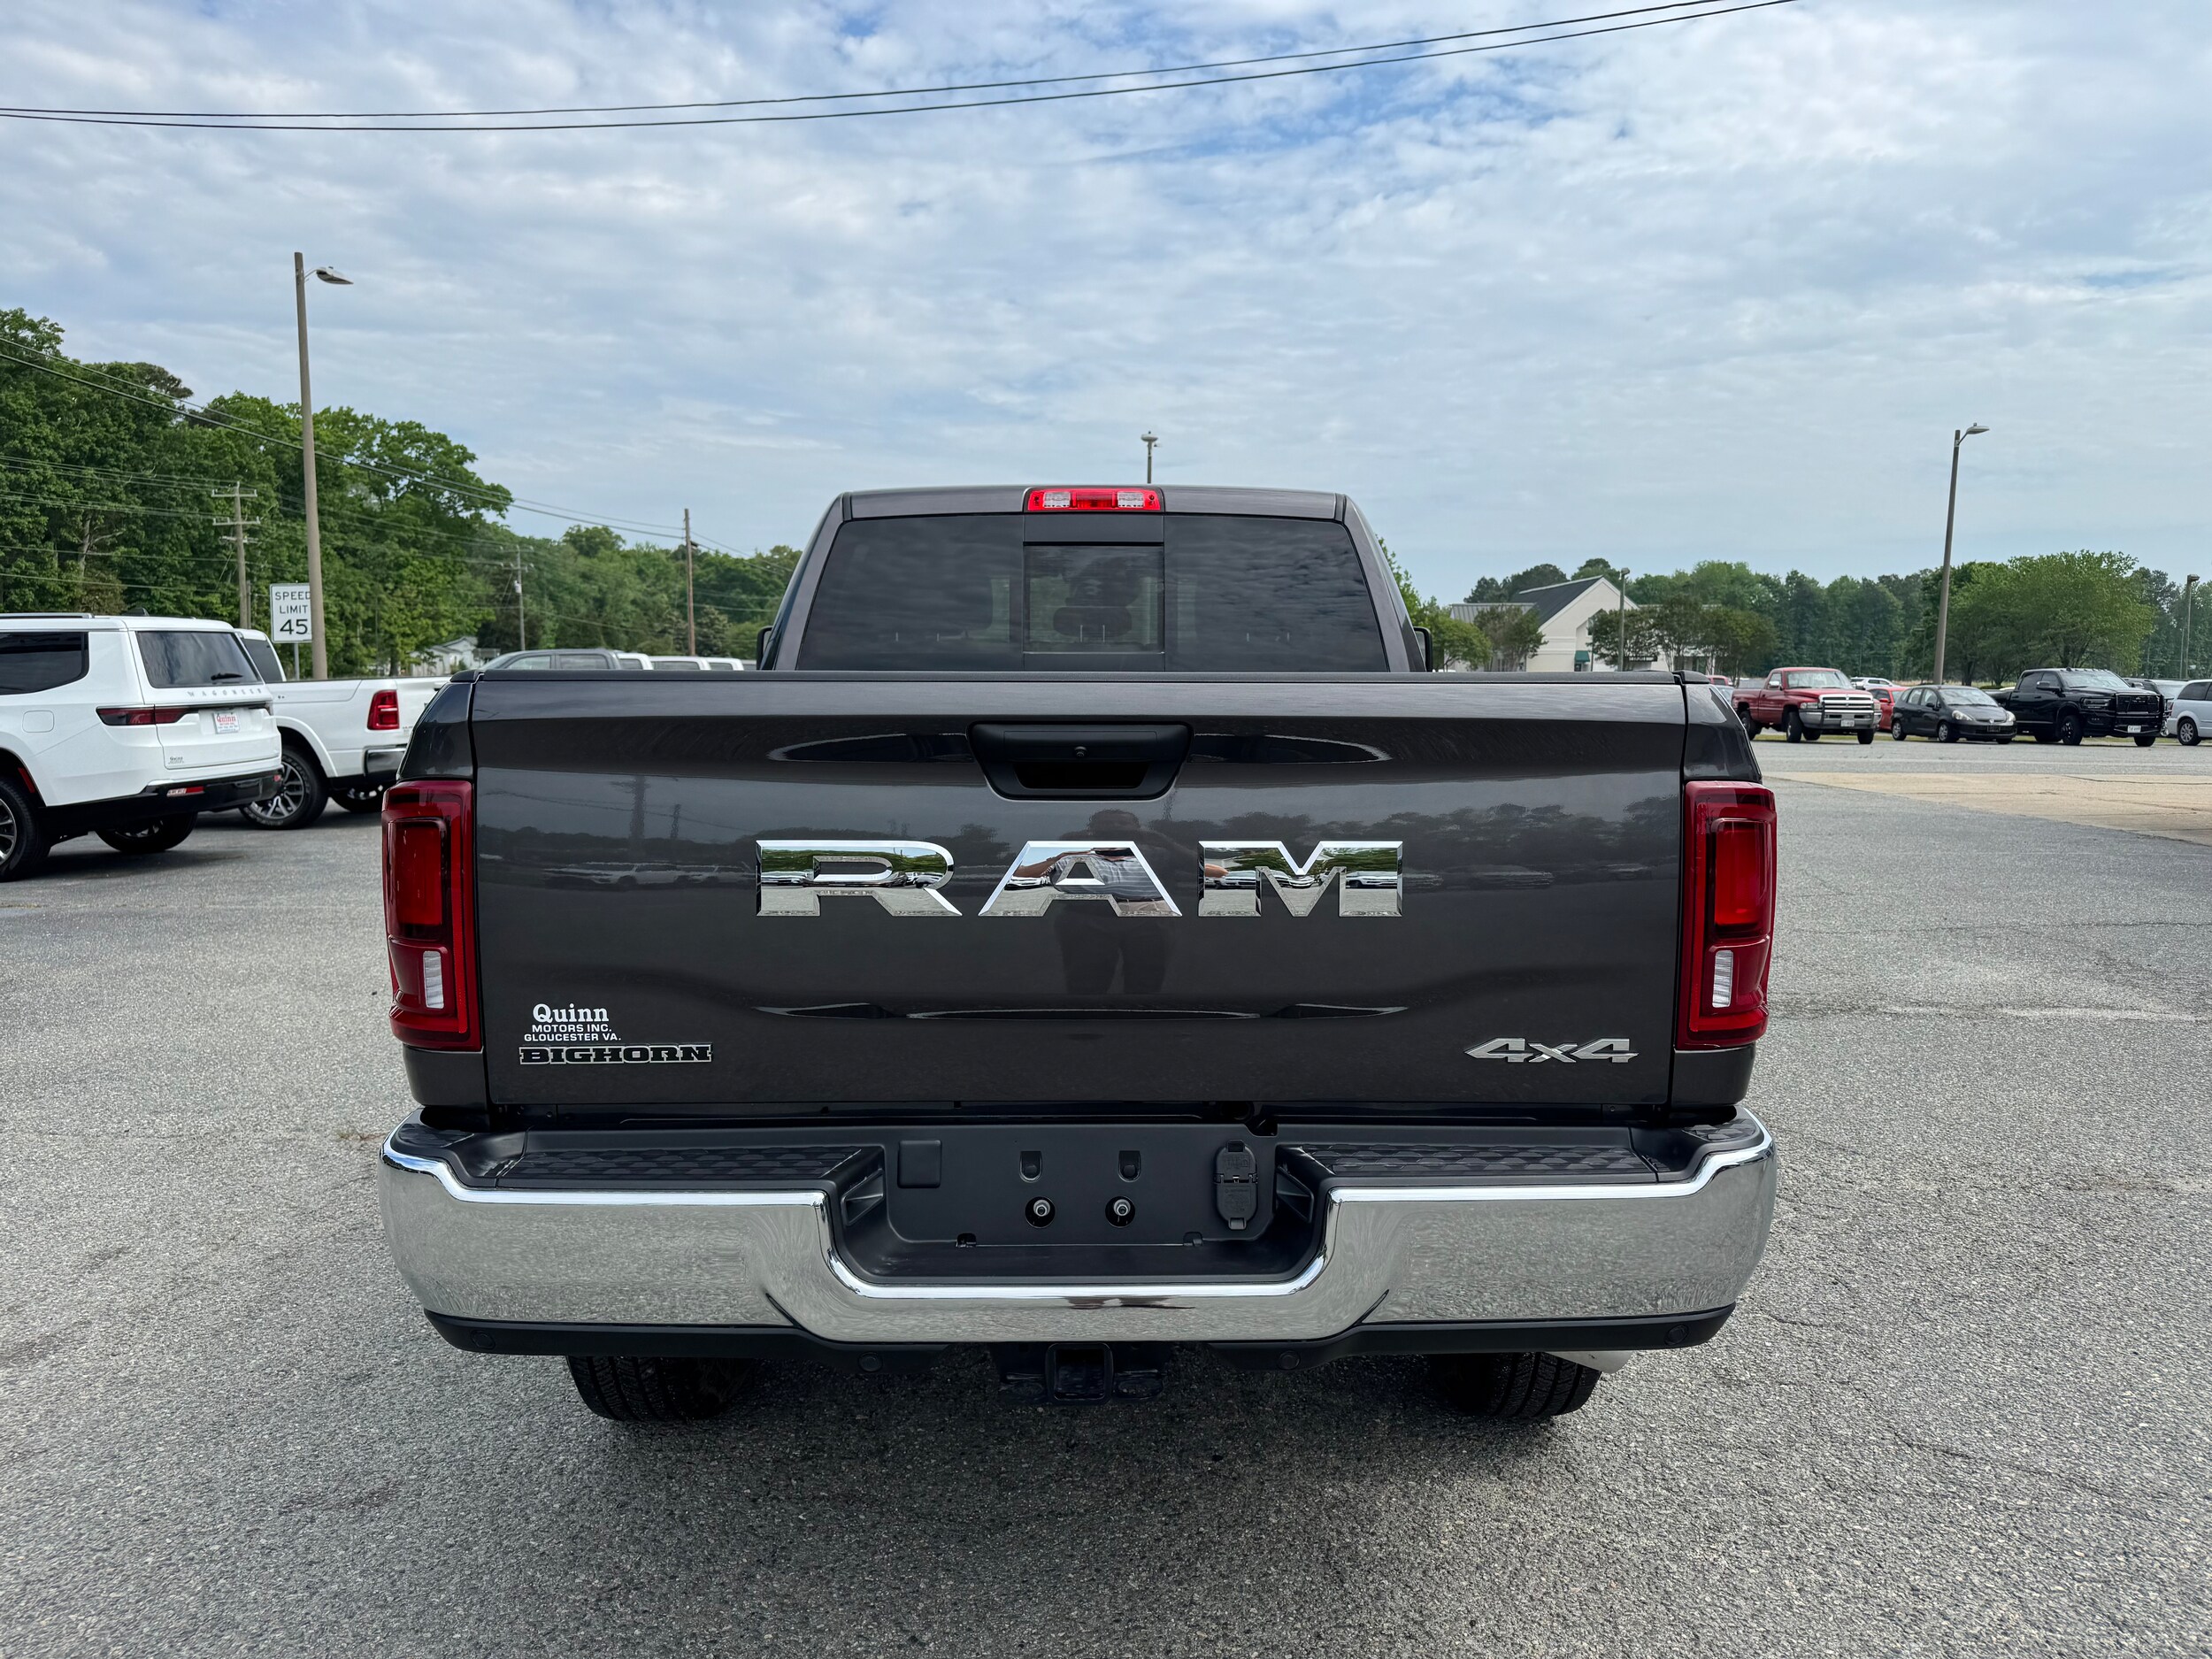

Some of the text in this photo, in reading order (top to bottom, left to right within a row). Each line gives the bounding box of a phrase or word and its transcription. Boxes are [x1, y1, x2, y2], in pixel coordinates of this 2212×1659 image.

[274, 591, 311, 601] SPEED
[279, 604, 308, 614] LIMIT
[280, 618, 308, 635] 45
[756, 840, 1405, 918] RAM
[533, 1002, 610, 1024] Quinn
[532, 1024, 612, 1033] MOTORS INC.
[524, 1033, 622, 1042] GLOUCESTER VA.
[518, 1044, 713, 1064] BIGHORN
